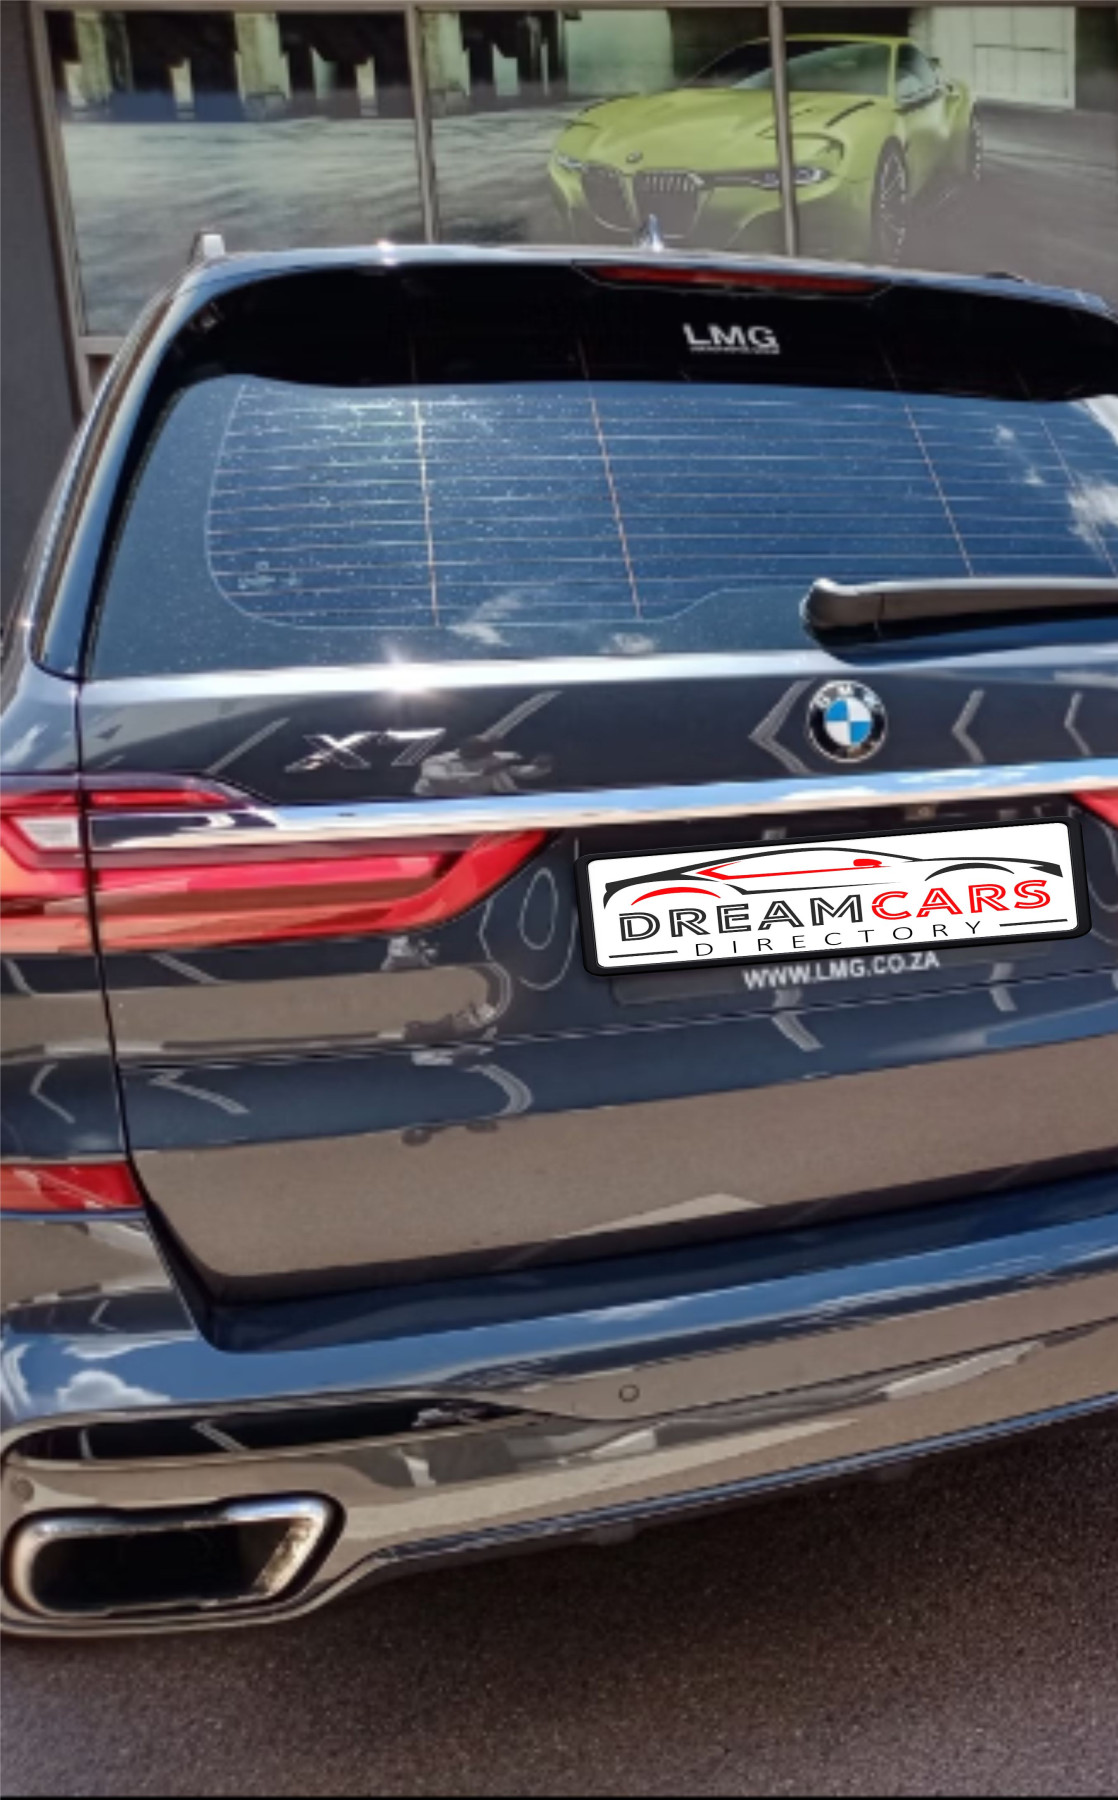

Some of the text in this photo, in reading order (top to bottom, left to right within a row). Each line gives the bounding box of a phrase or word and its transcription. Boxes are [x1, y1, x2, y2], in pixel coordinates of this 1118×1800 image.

[683, 323, 777, 348] LMG
[284, 727, 446, 773] X7
[742, 950, 940, 990] WWW.LMG.CO.ZA
